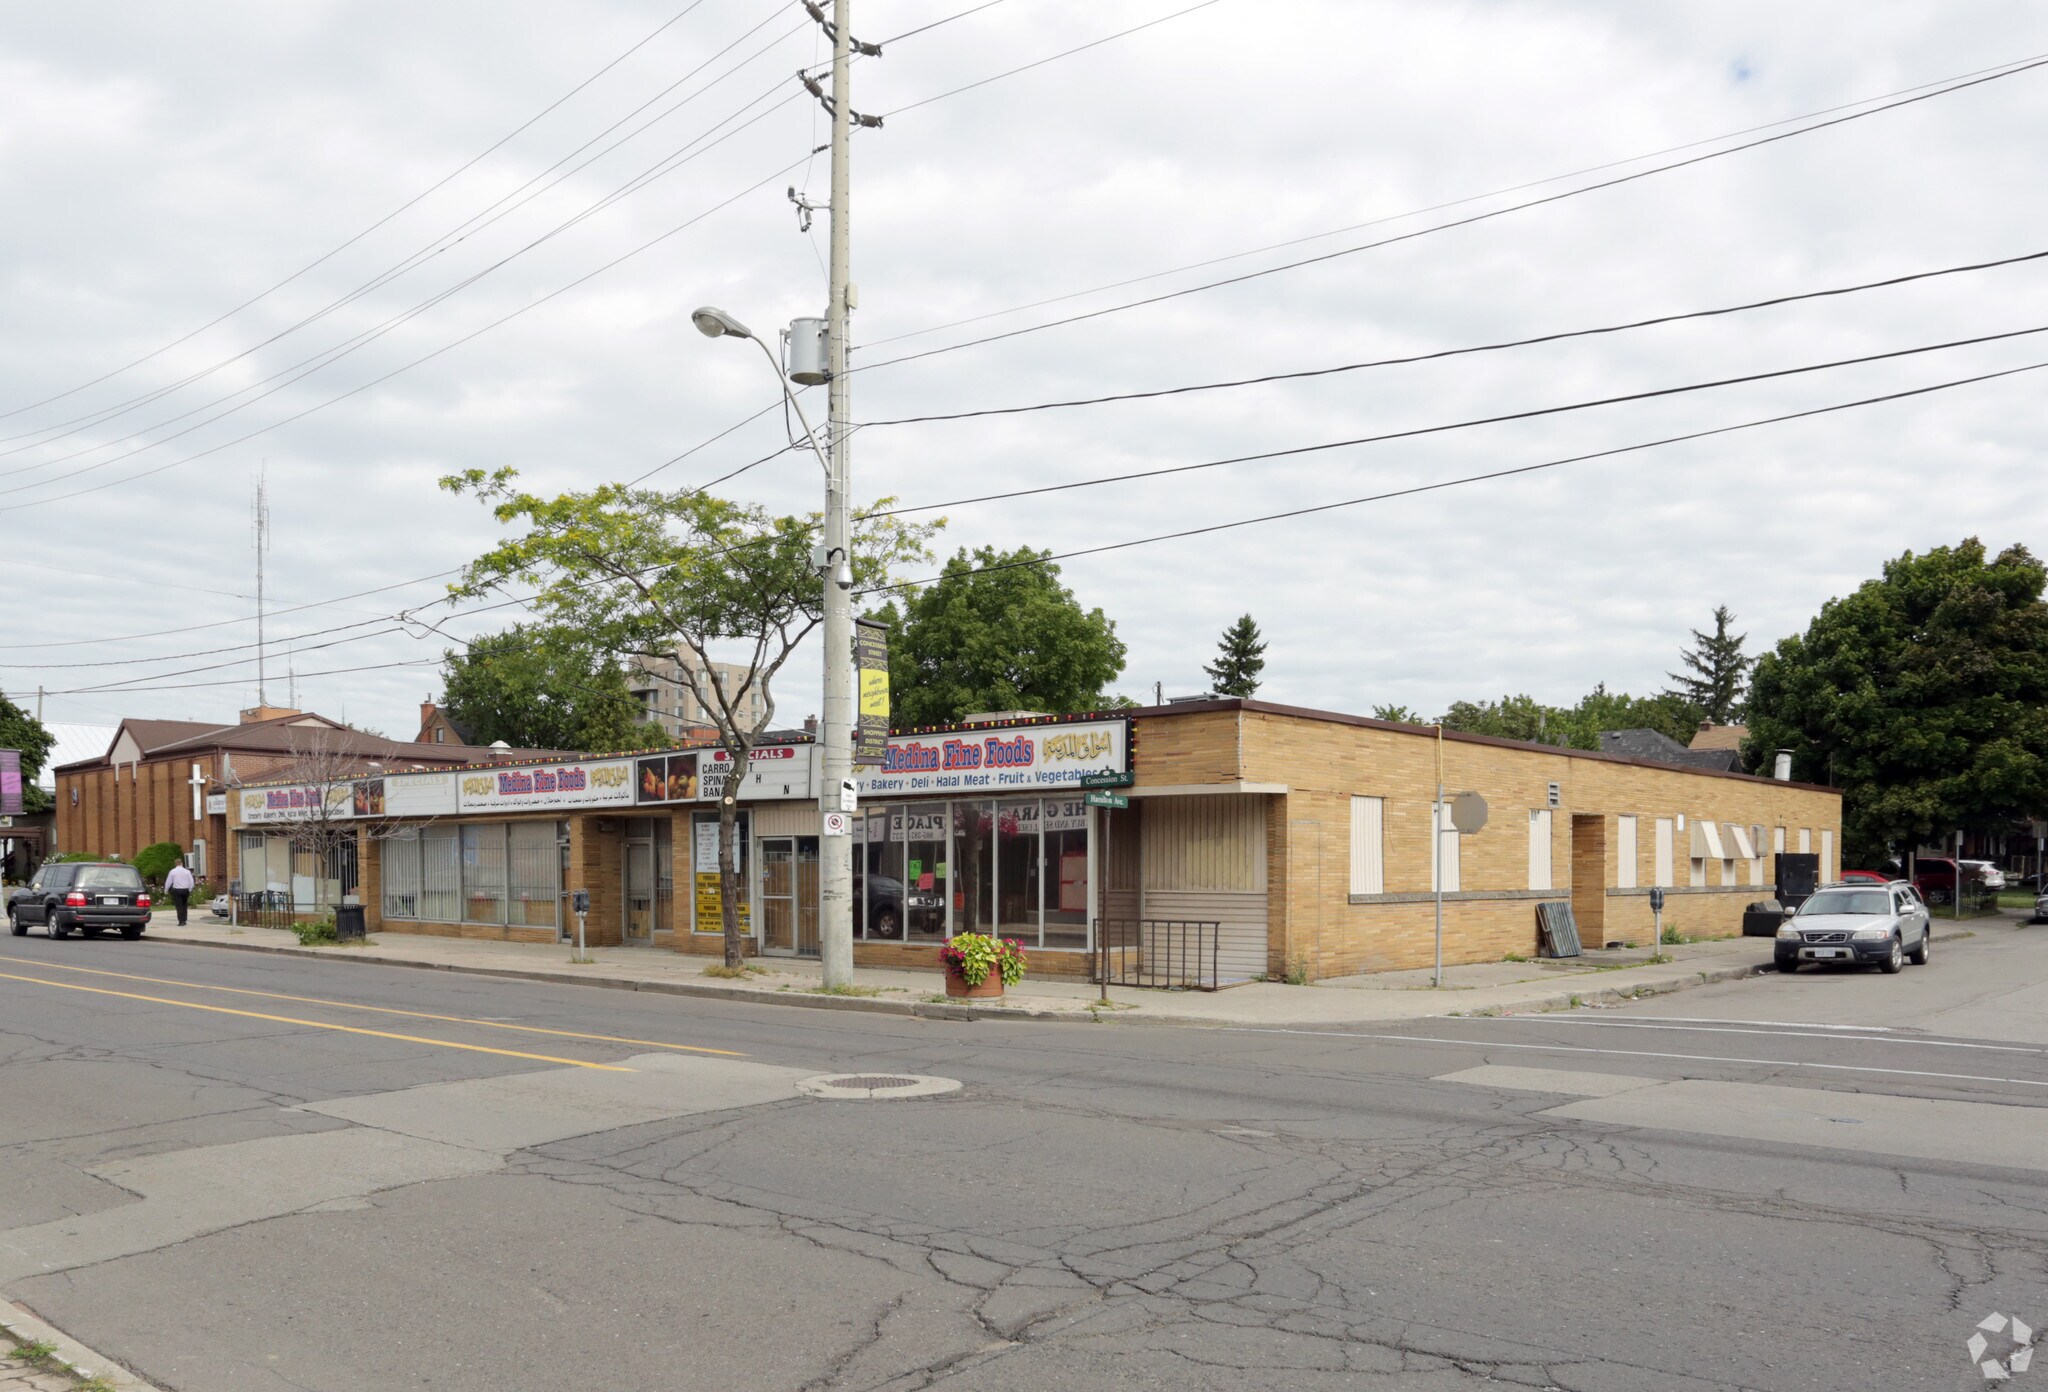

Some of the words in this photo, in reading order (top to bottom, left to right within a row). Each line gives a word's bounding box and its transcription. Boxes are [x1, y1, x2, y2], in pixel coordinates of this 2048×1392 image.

[863, 729, 887, 737] SHOPPING
[724, 749, 784, 760] SCIALS
[882, 743, 940, 773] Medina
[943, 740, 982, 768] Fine
[985, 736, 1034, 768] Foods
[702, 763, 730, 774] CARRO
[396, 776, 444, 786] SPECIALS
[498, 772, 533, 794] Medina
[533, 770, 556, 793] Fine
[557, 766, 586, 791] Foods
[871, 779, 904, 792] Bakery
[911, 775, 929, 788] Deli
[936, 775, 960, 787] Halal
[964, 773, 990, 786] Meat
[999, 772, 1024, 784] Fruit
[1027, 775, 1032, 783] &
[1085, 776, 1118, 785] Concession
[1120, 774, 1129, 782] St.
[703, 786, 726, 797] BANA
[1090, 794, 1112, 804] Hamilton
